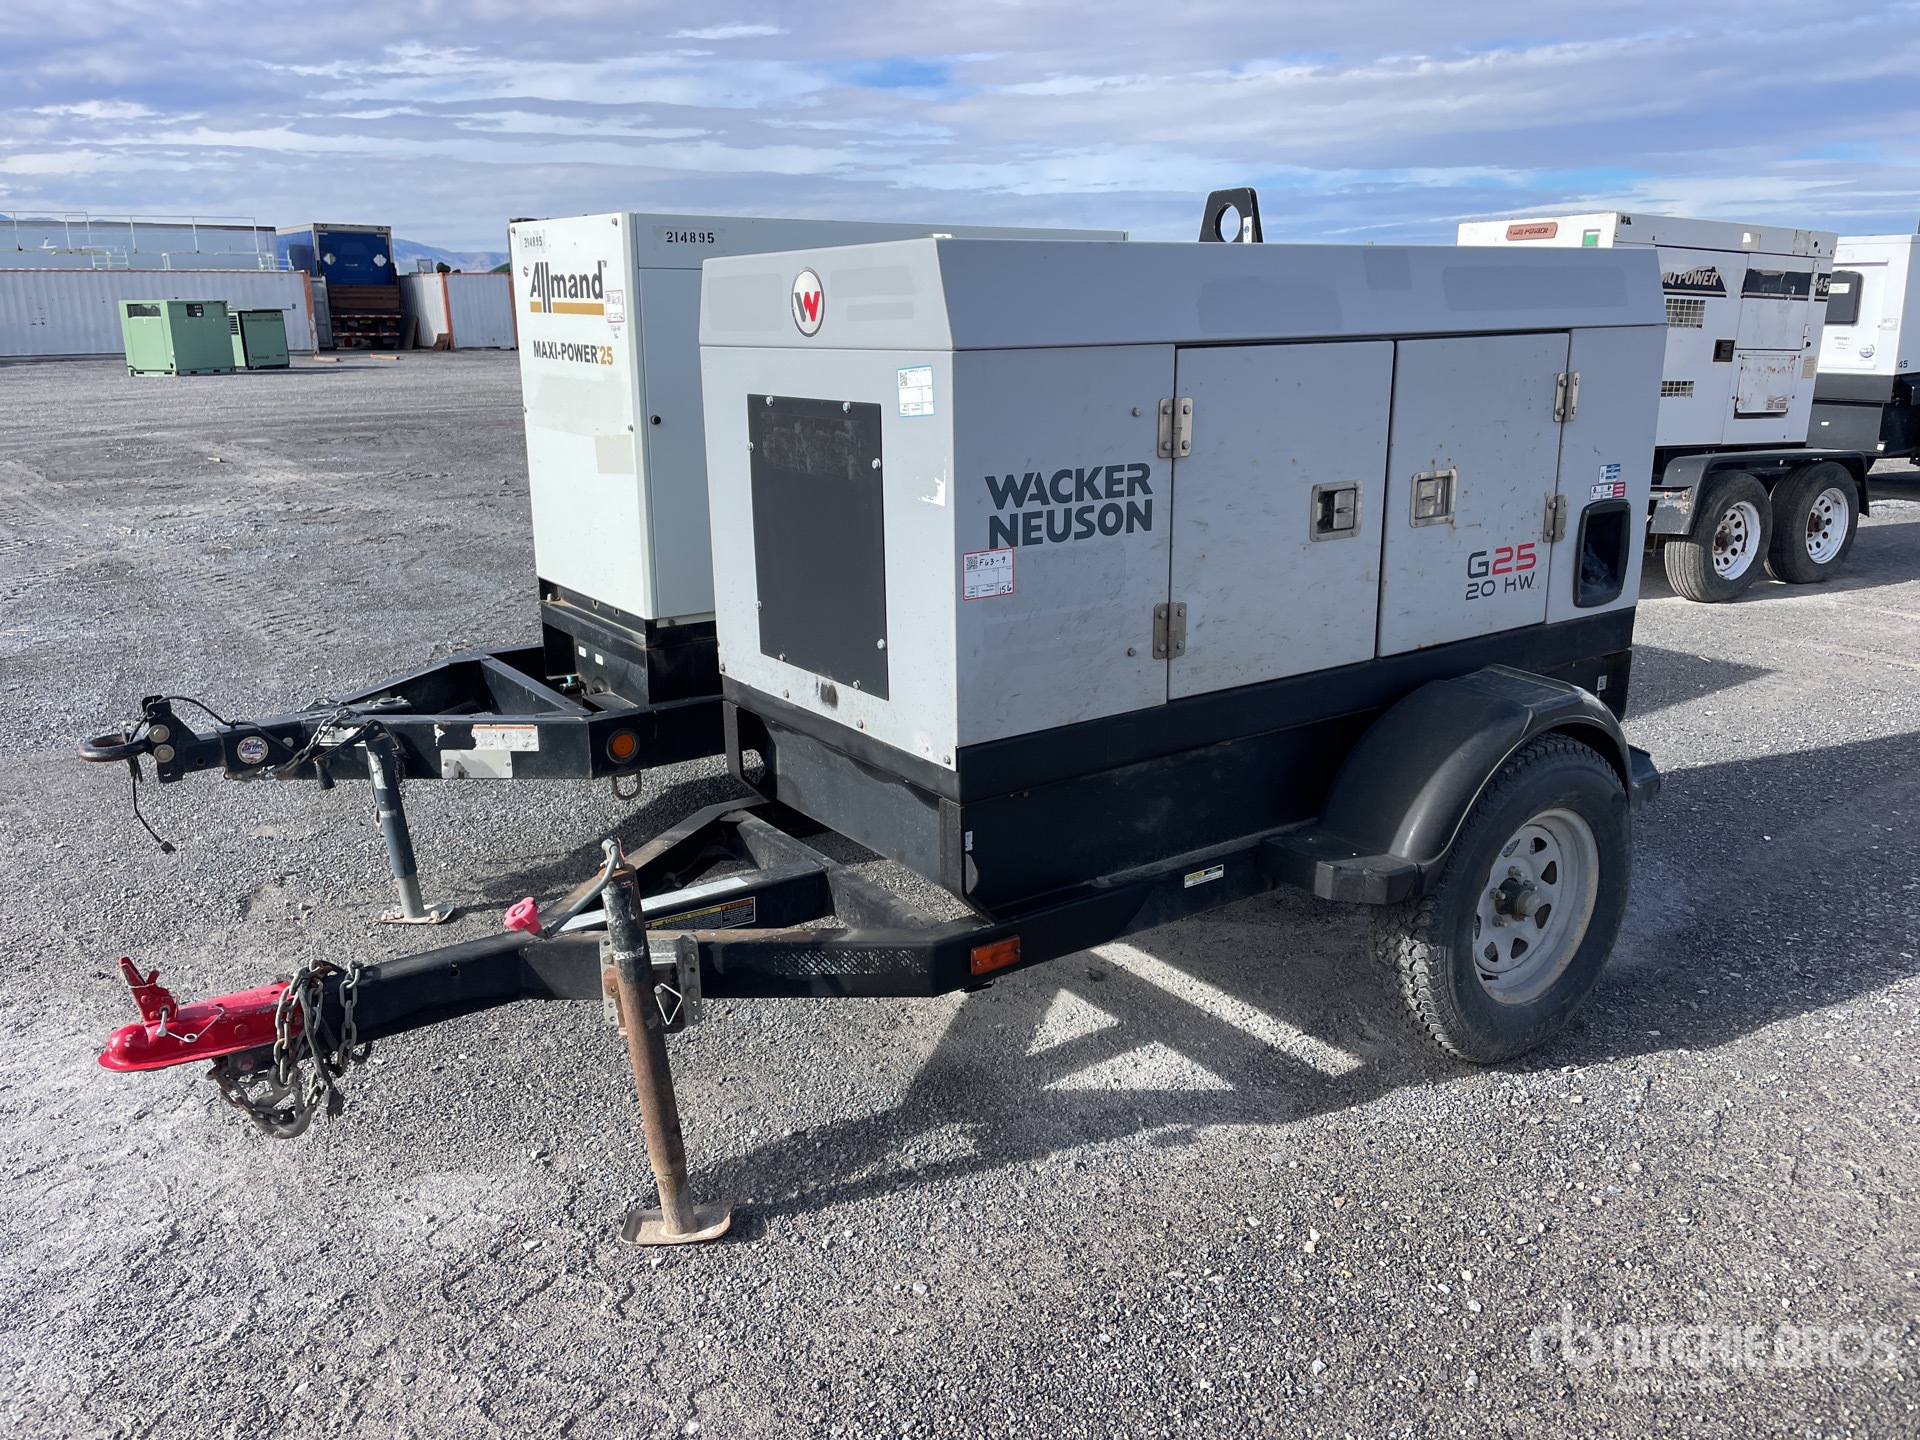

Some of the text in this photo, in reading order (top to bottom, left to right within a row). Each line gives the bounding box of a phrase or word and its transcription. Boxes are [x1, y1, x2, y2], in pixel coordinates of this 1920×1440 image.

[524, 236, 543, 248] 214895
[666, 231, 715, 244] 214895
[1524, 227, 1549, 235] POWER
[530, 260, 604, 313] Allmand
[1677, 270, 1719, 286] POWER
[533, 340, 614, 366] MAXI-POWER 25
[984, 462, 1153, 510] WACKER
[989, 499, 1153, 549] NEUSON
[1467, 543, 1537, 579] G25
[1465, 580, 1496, 601] 20
